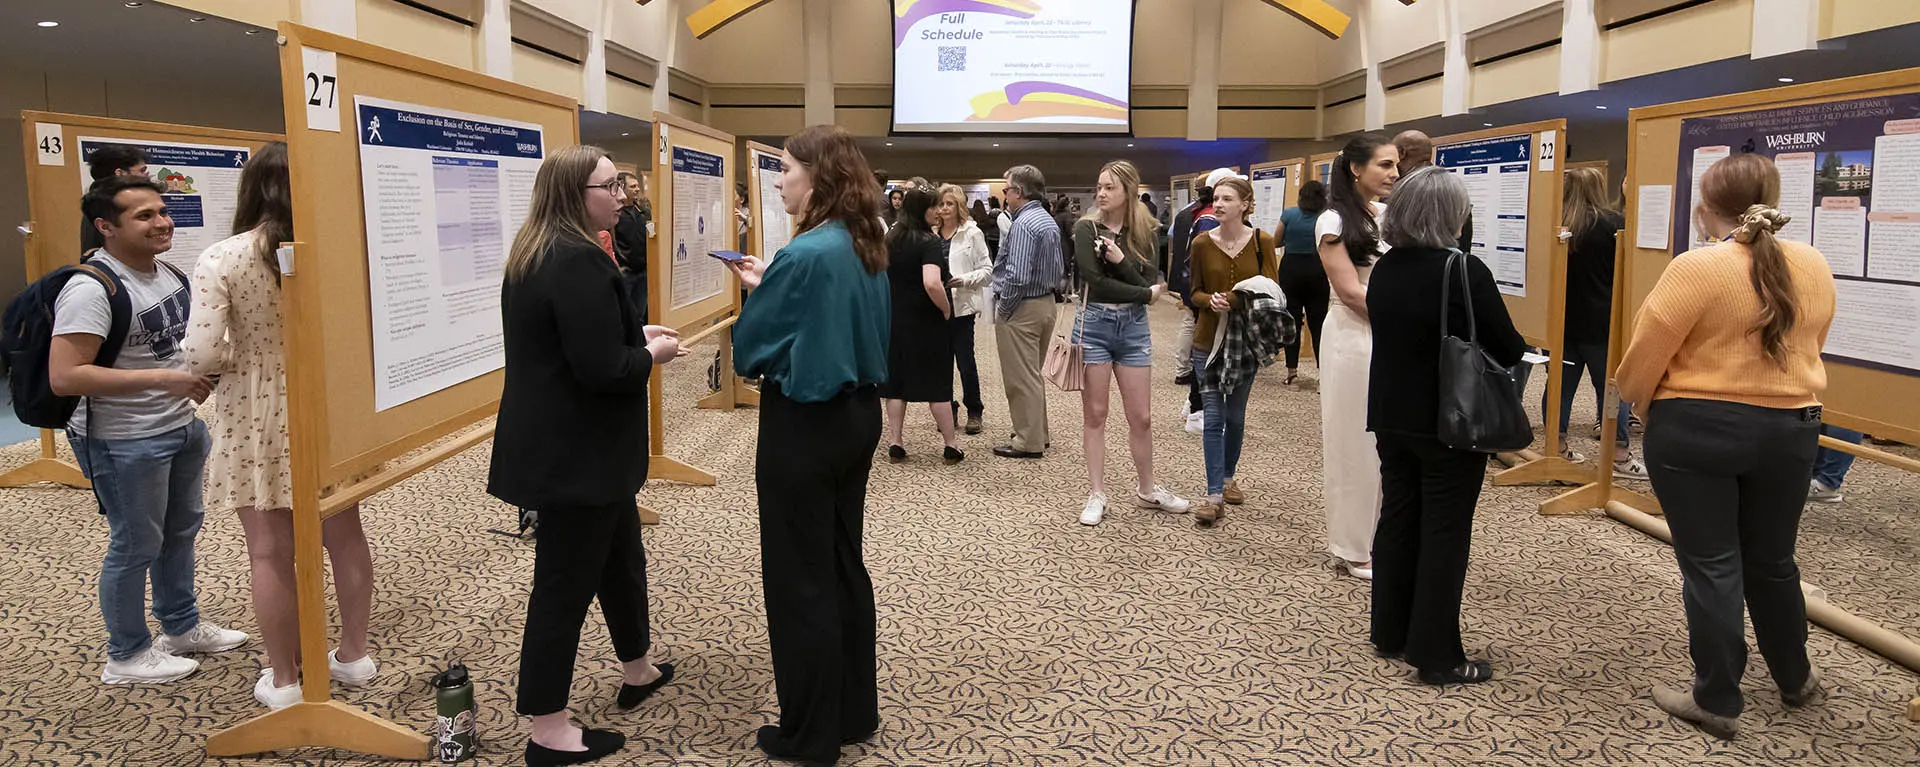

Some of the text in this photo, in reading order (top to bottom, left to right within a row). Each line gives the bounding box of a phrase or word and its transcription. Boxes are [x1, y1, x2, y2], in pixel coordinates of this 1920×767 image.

[940, 13, 965, 24] Full
[921, 29, 983, 40] Schedule
[307, 72, 336, 108] 27
[397, 112, 426, 124] Exclusion
[434, 118, 443, 127] the
[444, 118, 457, 128] Basis
[457, 120, 464, 129] of
[1819, 112, 1842, 120] CHILD
[1842, 106, 1894, 118] AGGRESSION
[39, 135, 62, 154] 43
[516, 142, 537, 151] WASHBURN
[1766, 131, 1826, 148] WASHBURN
[1541, 143, 1553, 159] 22
